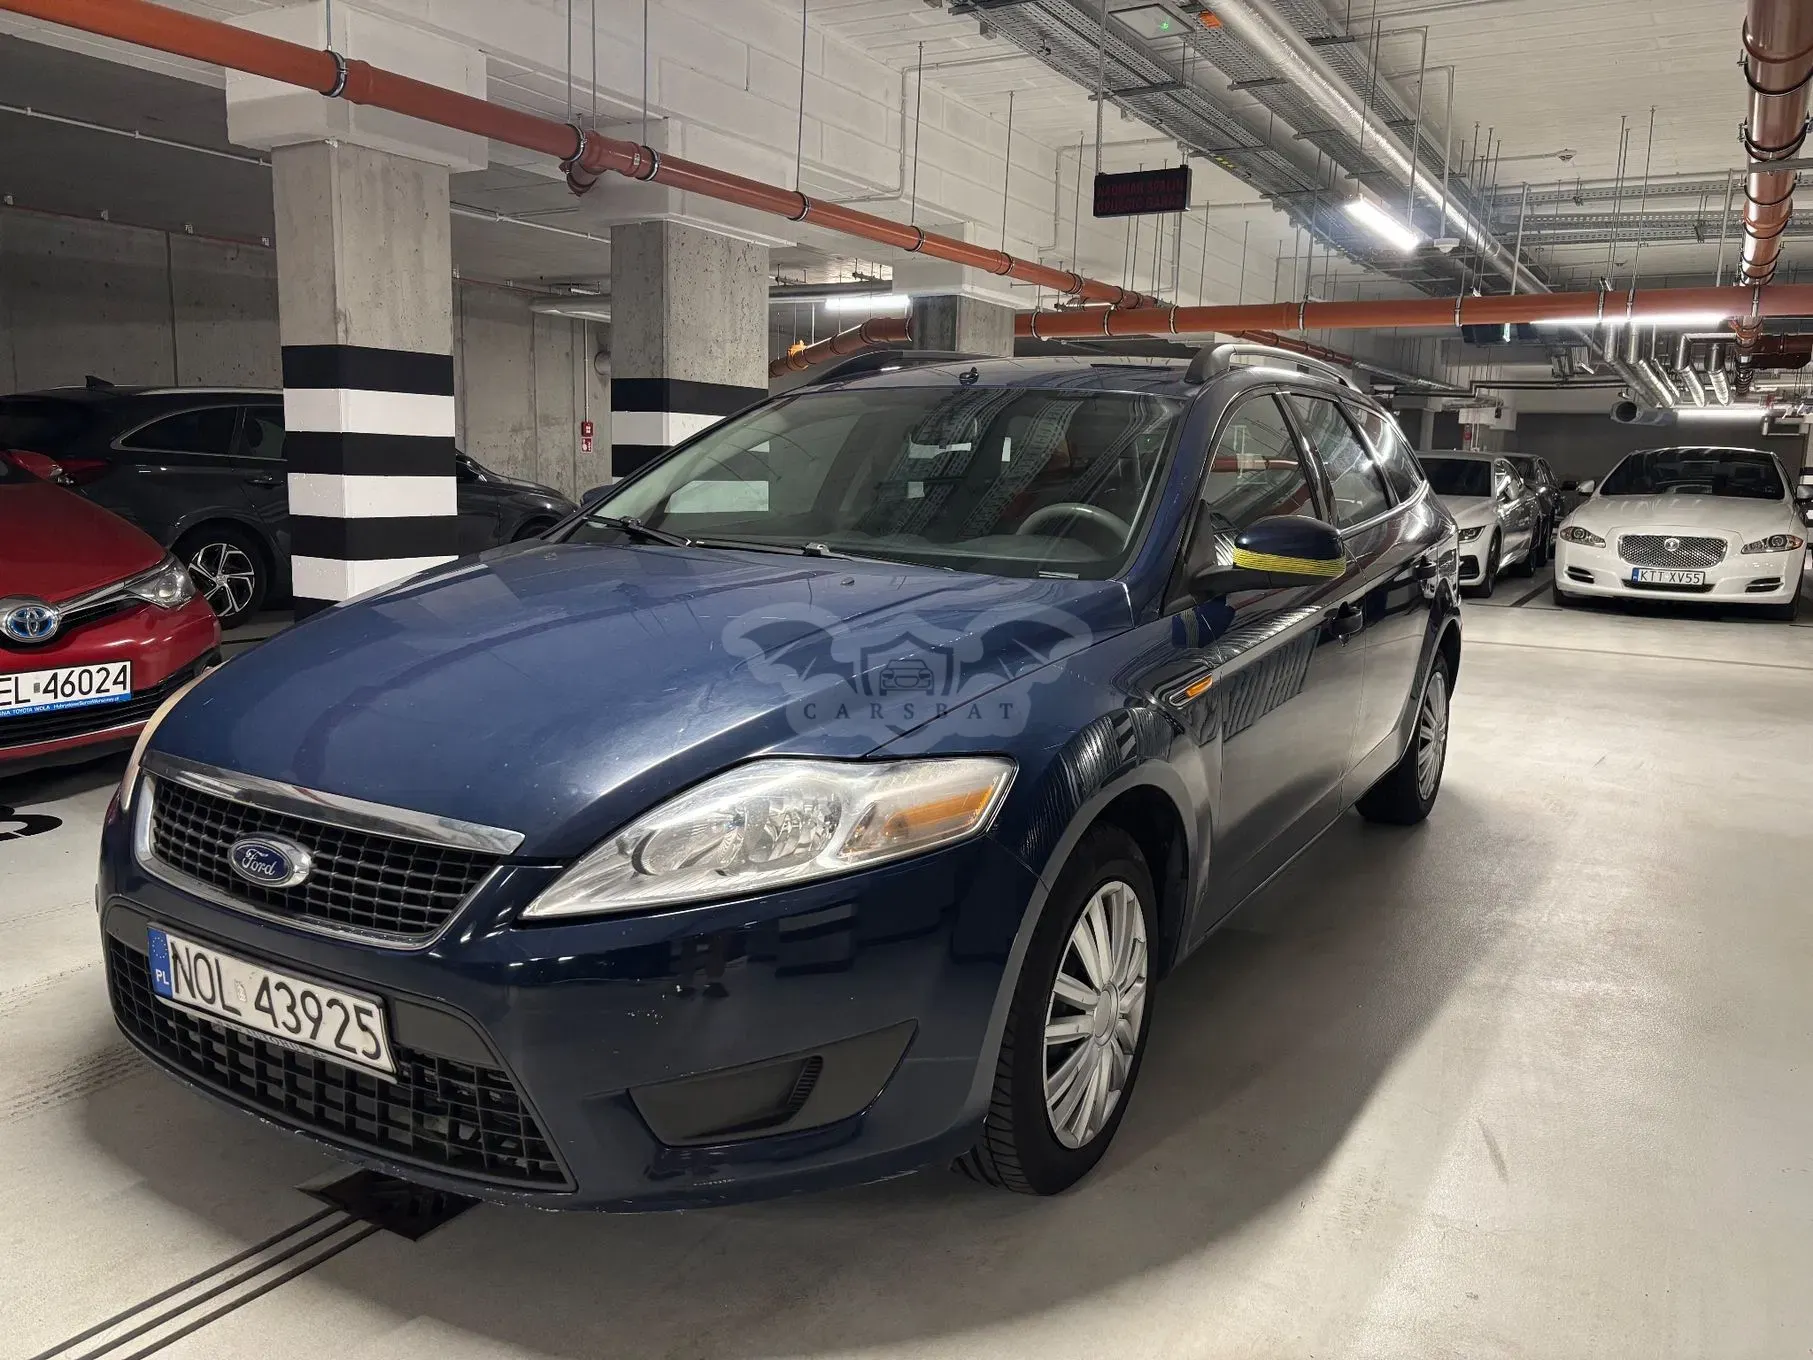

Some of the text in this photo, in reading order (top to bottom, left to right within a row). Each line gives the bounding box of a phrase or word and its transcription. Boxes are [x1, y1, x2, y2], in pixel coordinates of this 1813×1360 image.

[1641, 571, 1665, 582] KTT
[1669, 572, 1701, 584] XV55
[42, 664, 128, 699] 46024
[12, 707, 32, 715] TOYOTA
[241, 848, 278, 876] Ford
[155, 968, 170, 985] PL
[170, 942, 242, 1017] NOL
[254, 976, 382, 1061] 43925
